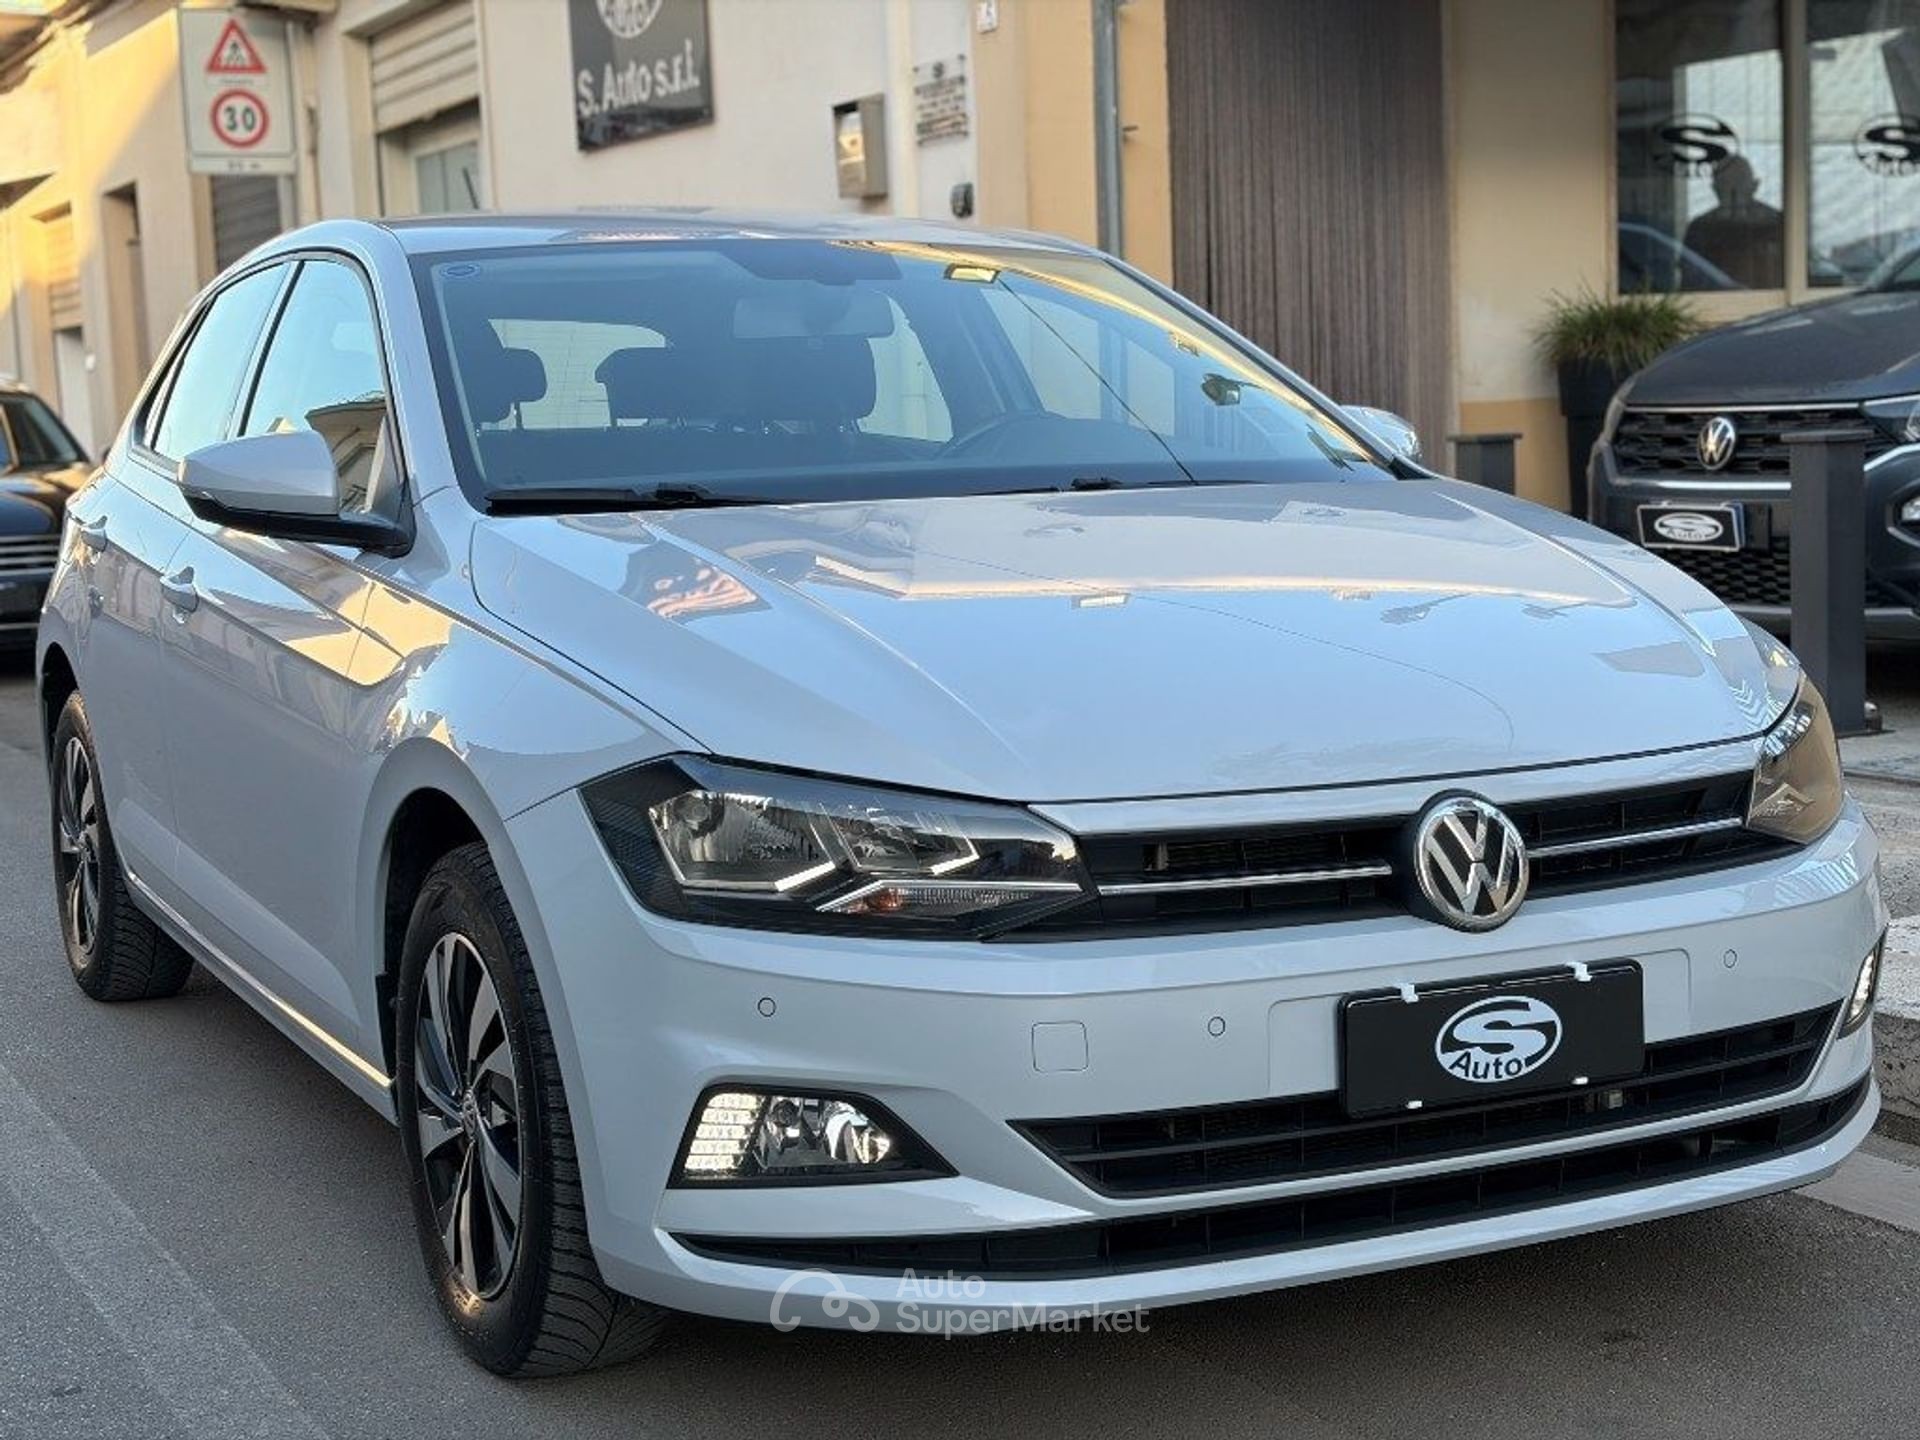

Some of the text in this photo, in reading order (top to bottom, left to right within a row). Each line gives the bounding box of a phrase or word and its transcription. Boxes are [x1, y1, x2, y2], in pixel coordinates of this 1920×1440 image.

[223, 105, 257, 132] 30
[1700, 418, 1733, 465] VW
[1666, 526, 1704, 540] Auto
[1420, 803, 1520, 918] VW
[1451, 1000, 1557, 1058] S
[1448, 1051, 1524, 1080] Auto
